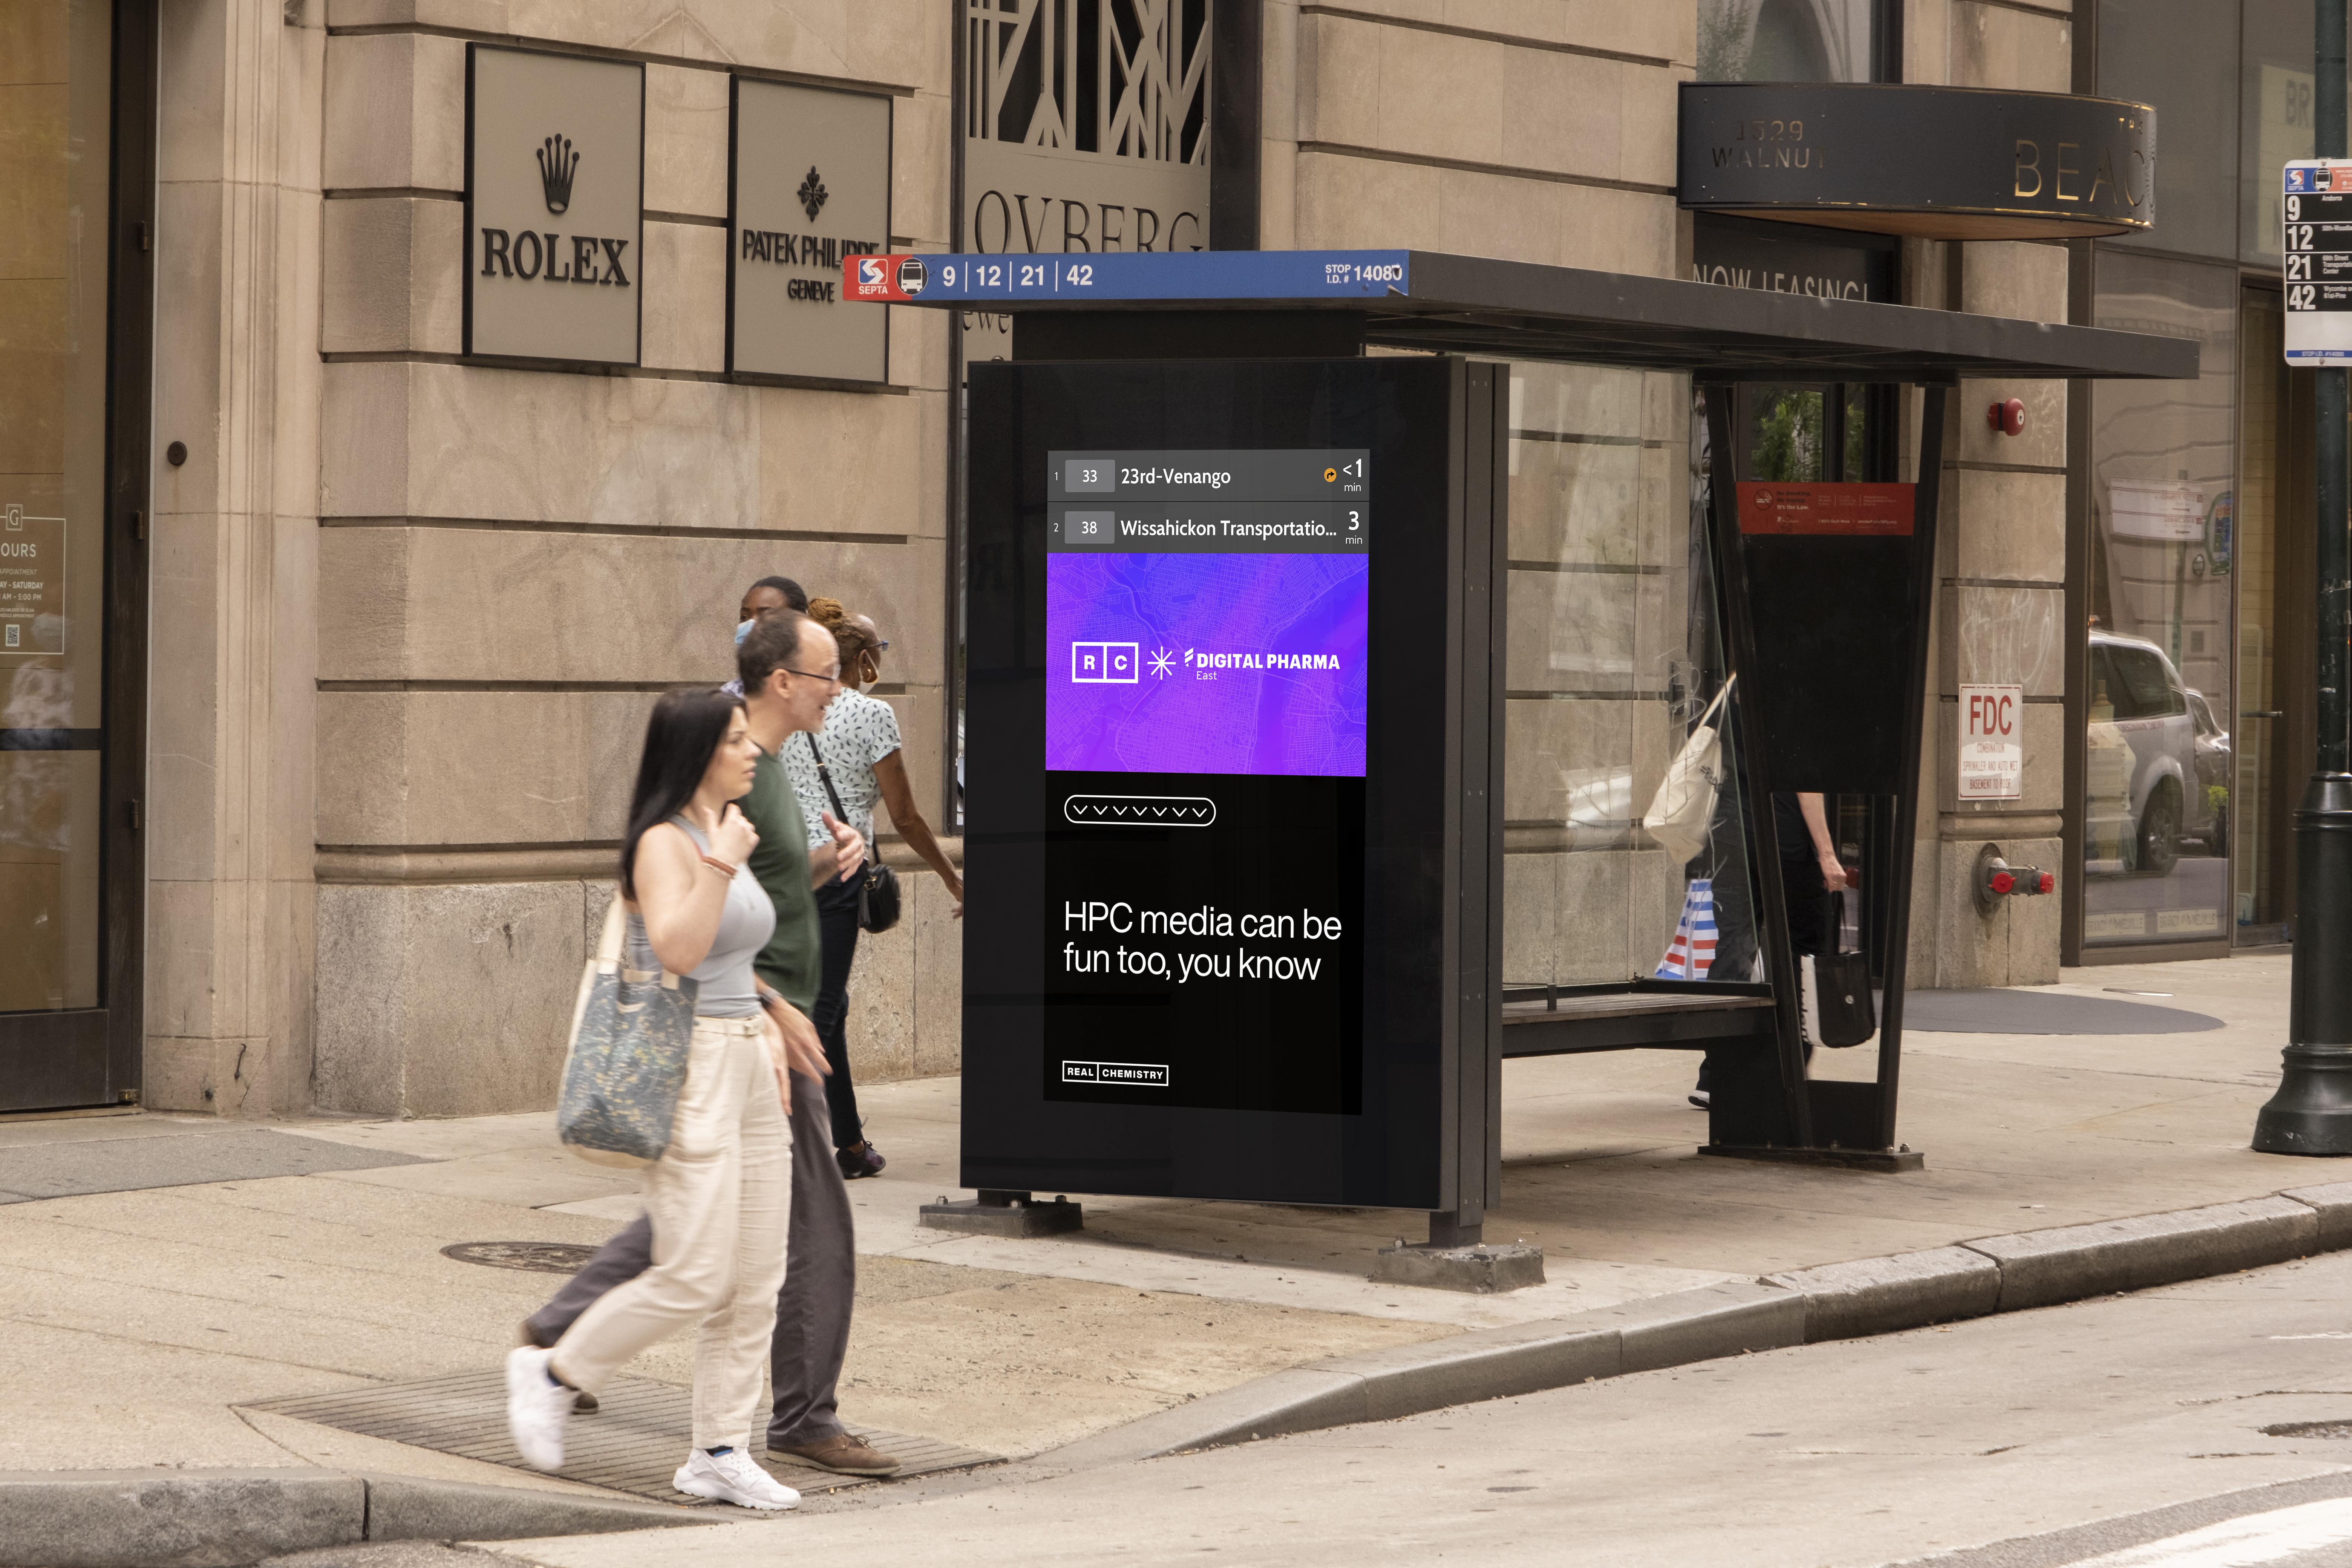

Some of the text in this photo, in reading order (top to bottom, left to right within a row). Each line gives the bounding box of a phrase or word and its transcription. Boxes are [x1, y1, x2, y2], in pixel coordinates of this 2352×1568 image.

[1736, 121, 1803, 141] 1529
[1712, 147, 1825, 168] WALNUT
[2287, 195, 2300, 221] 9
[743, 229, 798, 265] PATEK
[2288, 225, 2314, 250] 12
[481, 227, 631, 288] ROLEX
[2288, 254, 2311, 280] 21
[943, 265, 1093, 287] 9 12 21 42
[1325, 264, 1351, 273] STOP
[1327, 274, 1341, 283] I.D.
[1354, 264, 1403, 281] 14080
[787, 278, 835, 302] GENEVE
[859, 285, 888, 295] SEPTA
[2289, 285, 2316, 310] 42
[1055, 472, 1058, 481] 1
[1082, 470, 1098, 483] 33
[1121, 467, 1231, 489] 23rd-Venango
[1054, 523, 1059, 532] 2
[1081, 521, 1098, 534] 38
[1121, 519, 1216, 536] Wissahickon
[1348, 510, 1360, 531] 3
[0, 542, 37, 558] OURS
[1084, 653, 1340, 671] R C DIGITAL PHARMA
[1196, 671, 1217, 680] East
[1969, 695, 2012, 736] FDC
[1977, 743, 2004, 753] COMBINATION
[1963, 761, 2018, 771] SPRINKLER AND AUTO WET
[1970, 779, 2011, 789] BASEMENT TO ROOF
[1065, 901, 1342, 940] HPC media can be
[1063, 942, 1321, 983] fun too, you know
[1067, 1067, 1163, 1080] REAL CHEMISTRY
